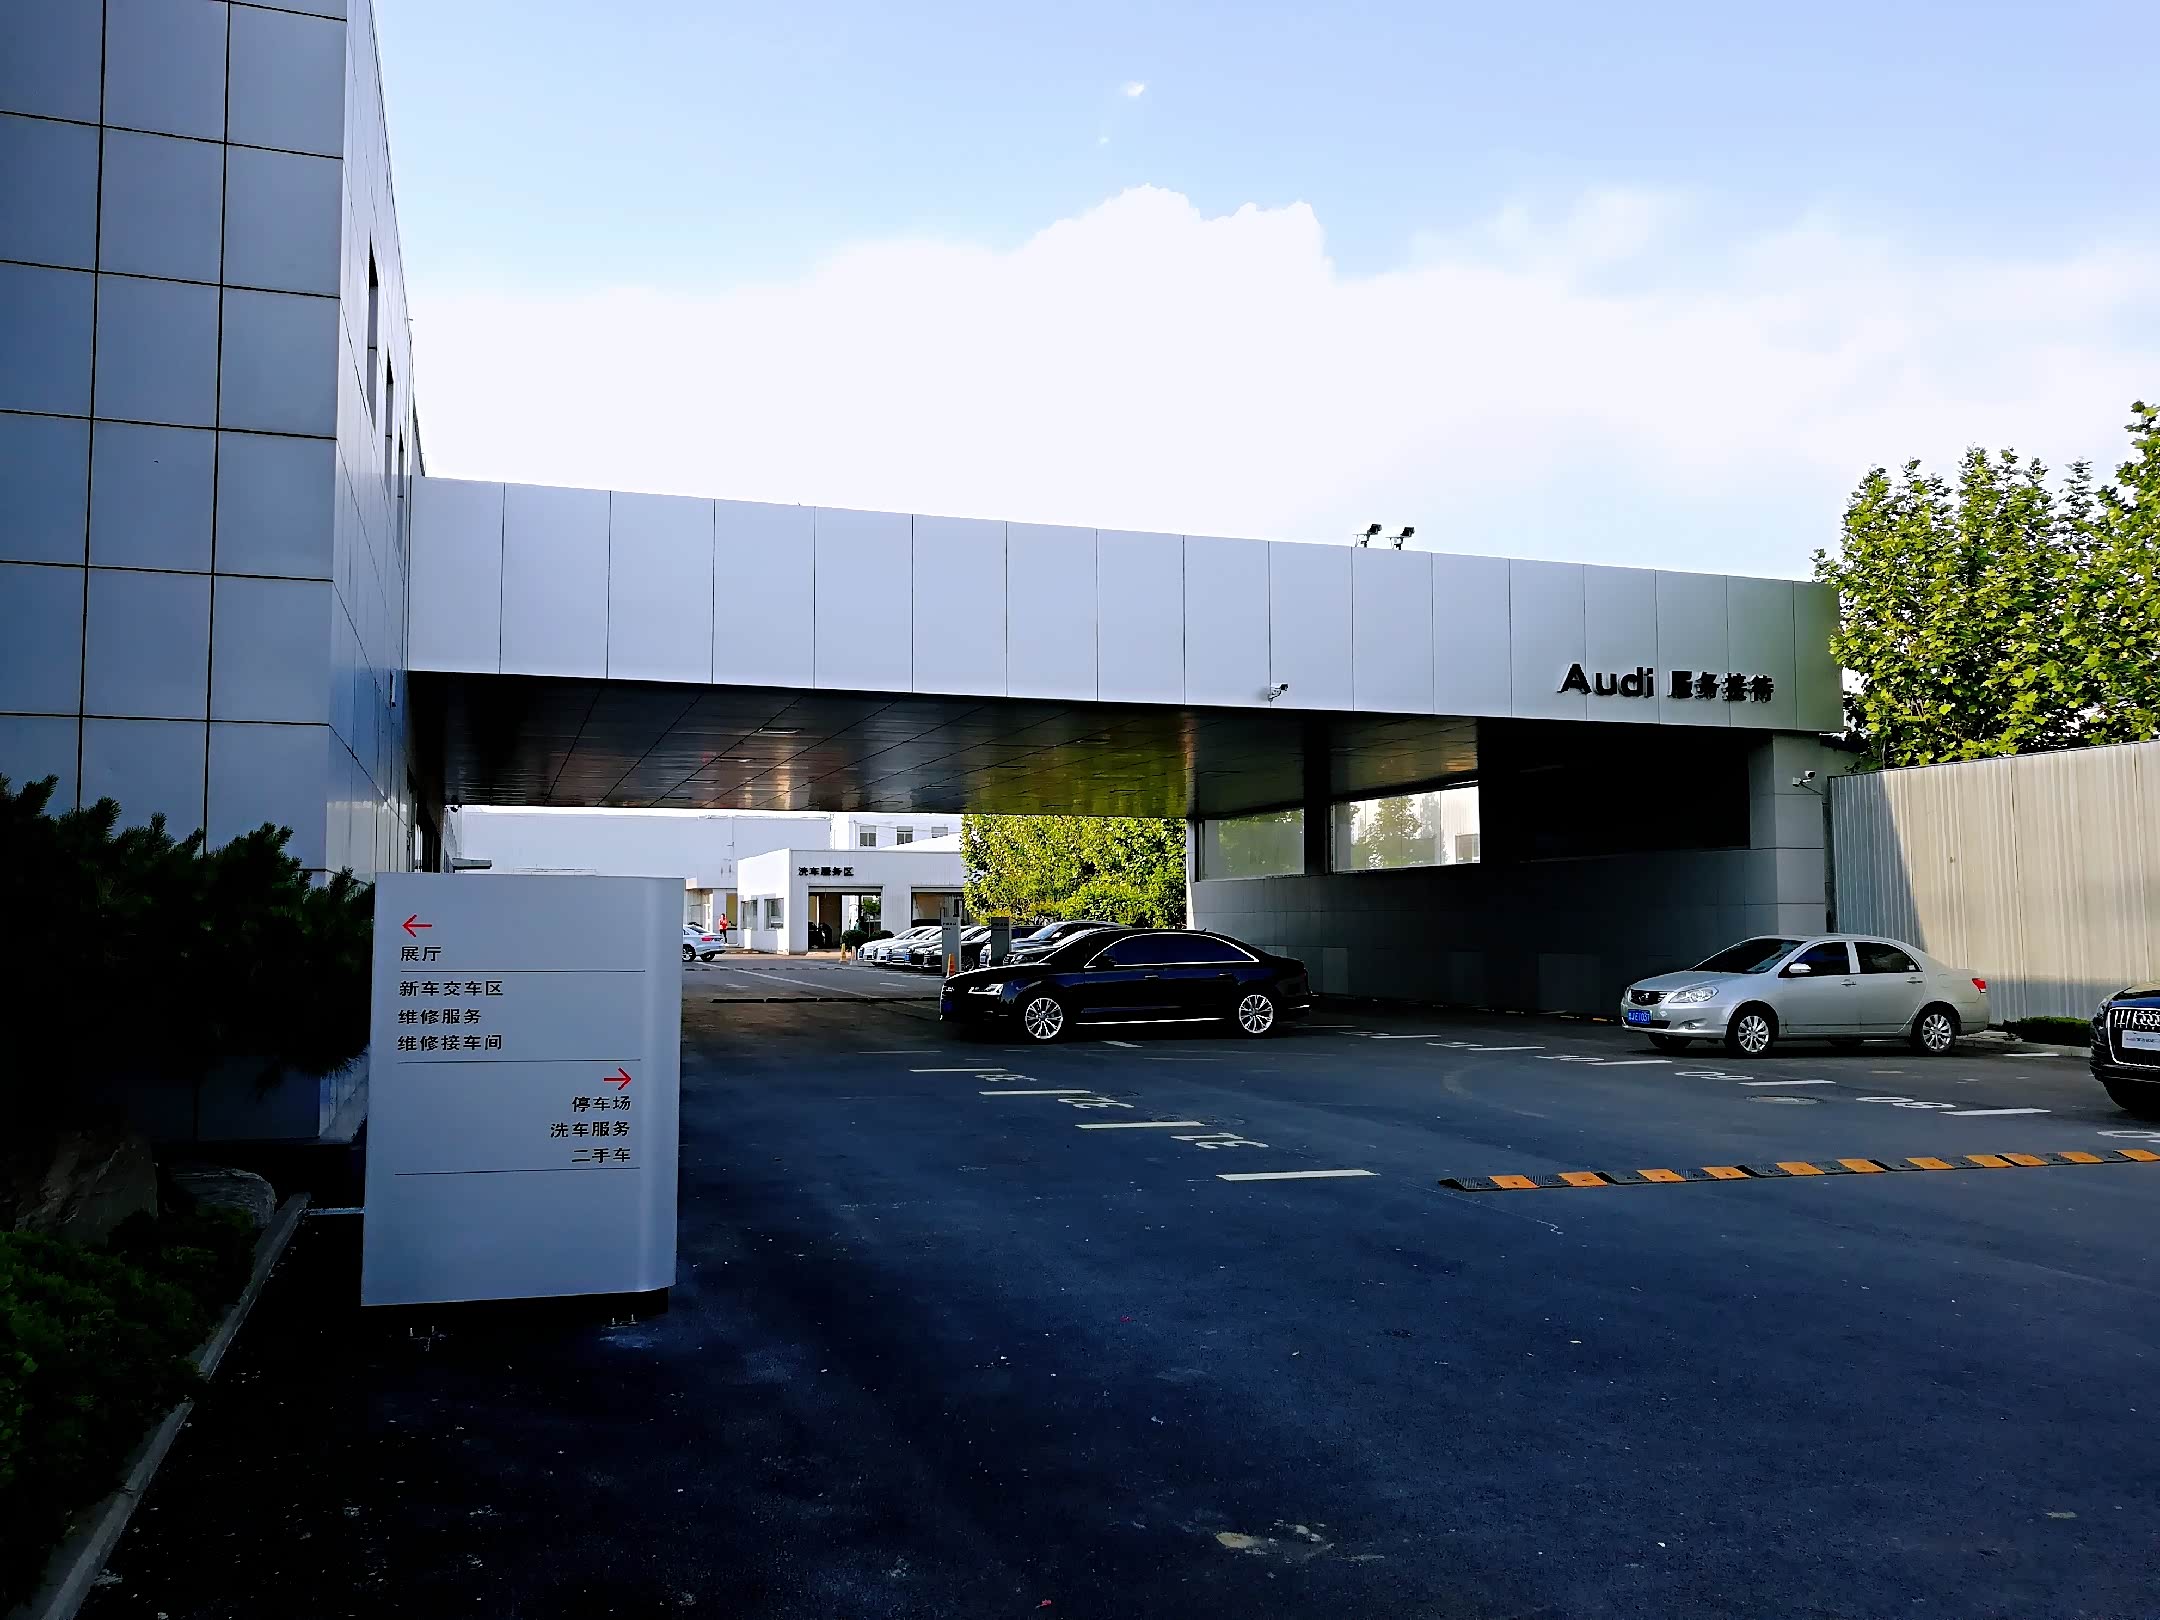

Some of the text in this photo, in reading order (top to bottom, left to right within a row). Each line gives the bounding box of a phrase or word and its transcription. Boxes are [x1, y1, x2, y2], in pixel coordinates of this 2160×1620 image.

[1557, 663, 1774, 702] Audi 服务接待
[798, 866, 854, 877] 洗车服务区
[400, 945, 442, 962] 展厅
[399, 980, 504, 997] 新车交车区
[397, 1008, 482, 1025] 维修服务
[397, 1034, 503, 1051] 维修接车间
[571, 1095, 632, 1113] 停车场
[549, 1120, 631, 1138] 洗车服务
[1170, 1132, 1269, 1149] 31
[571, 1147, 631, 1164] 二手车
